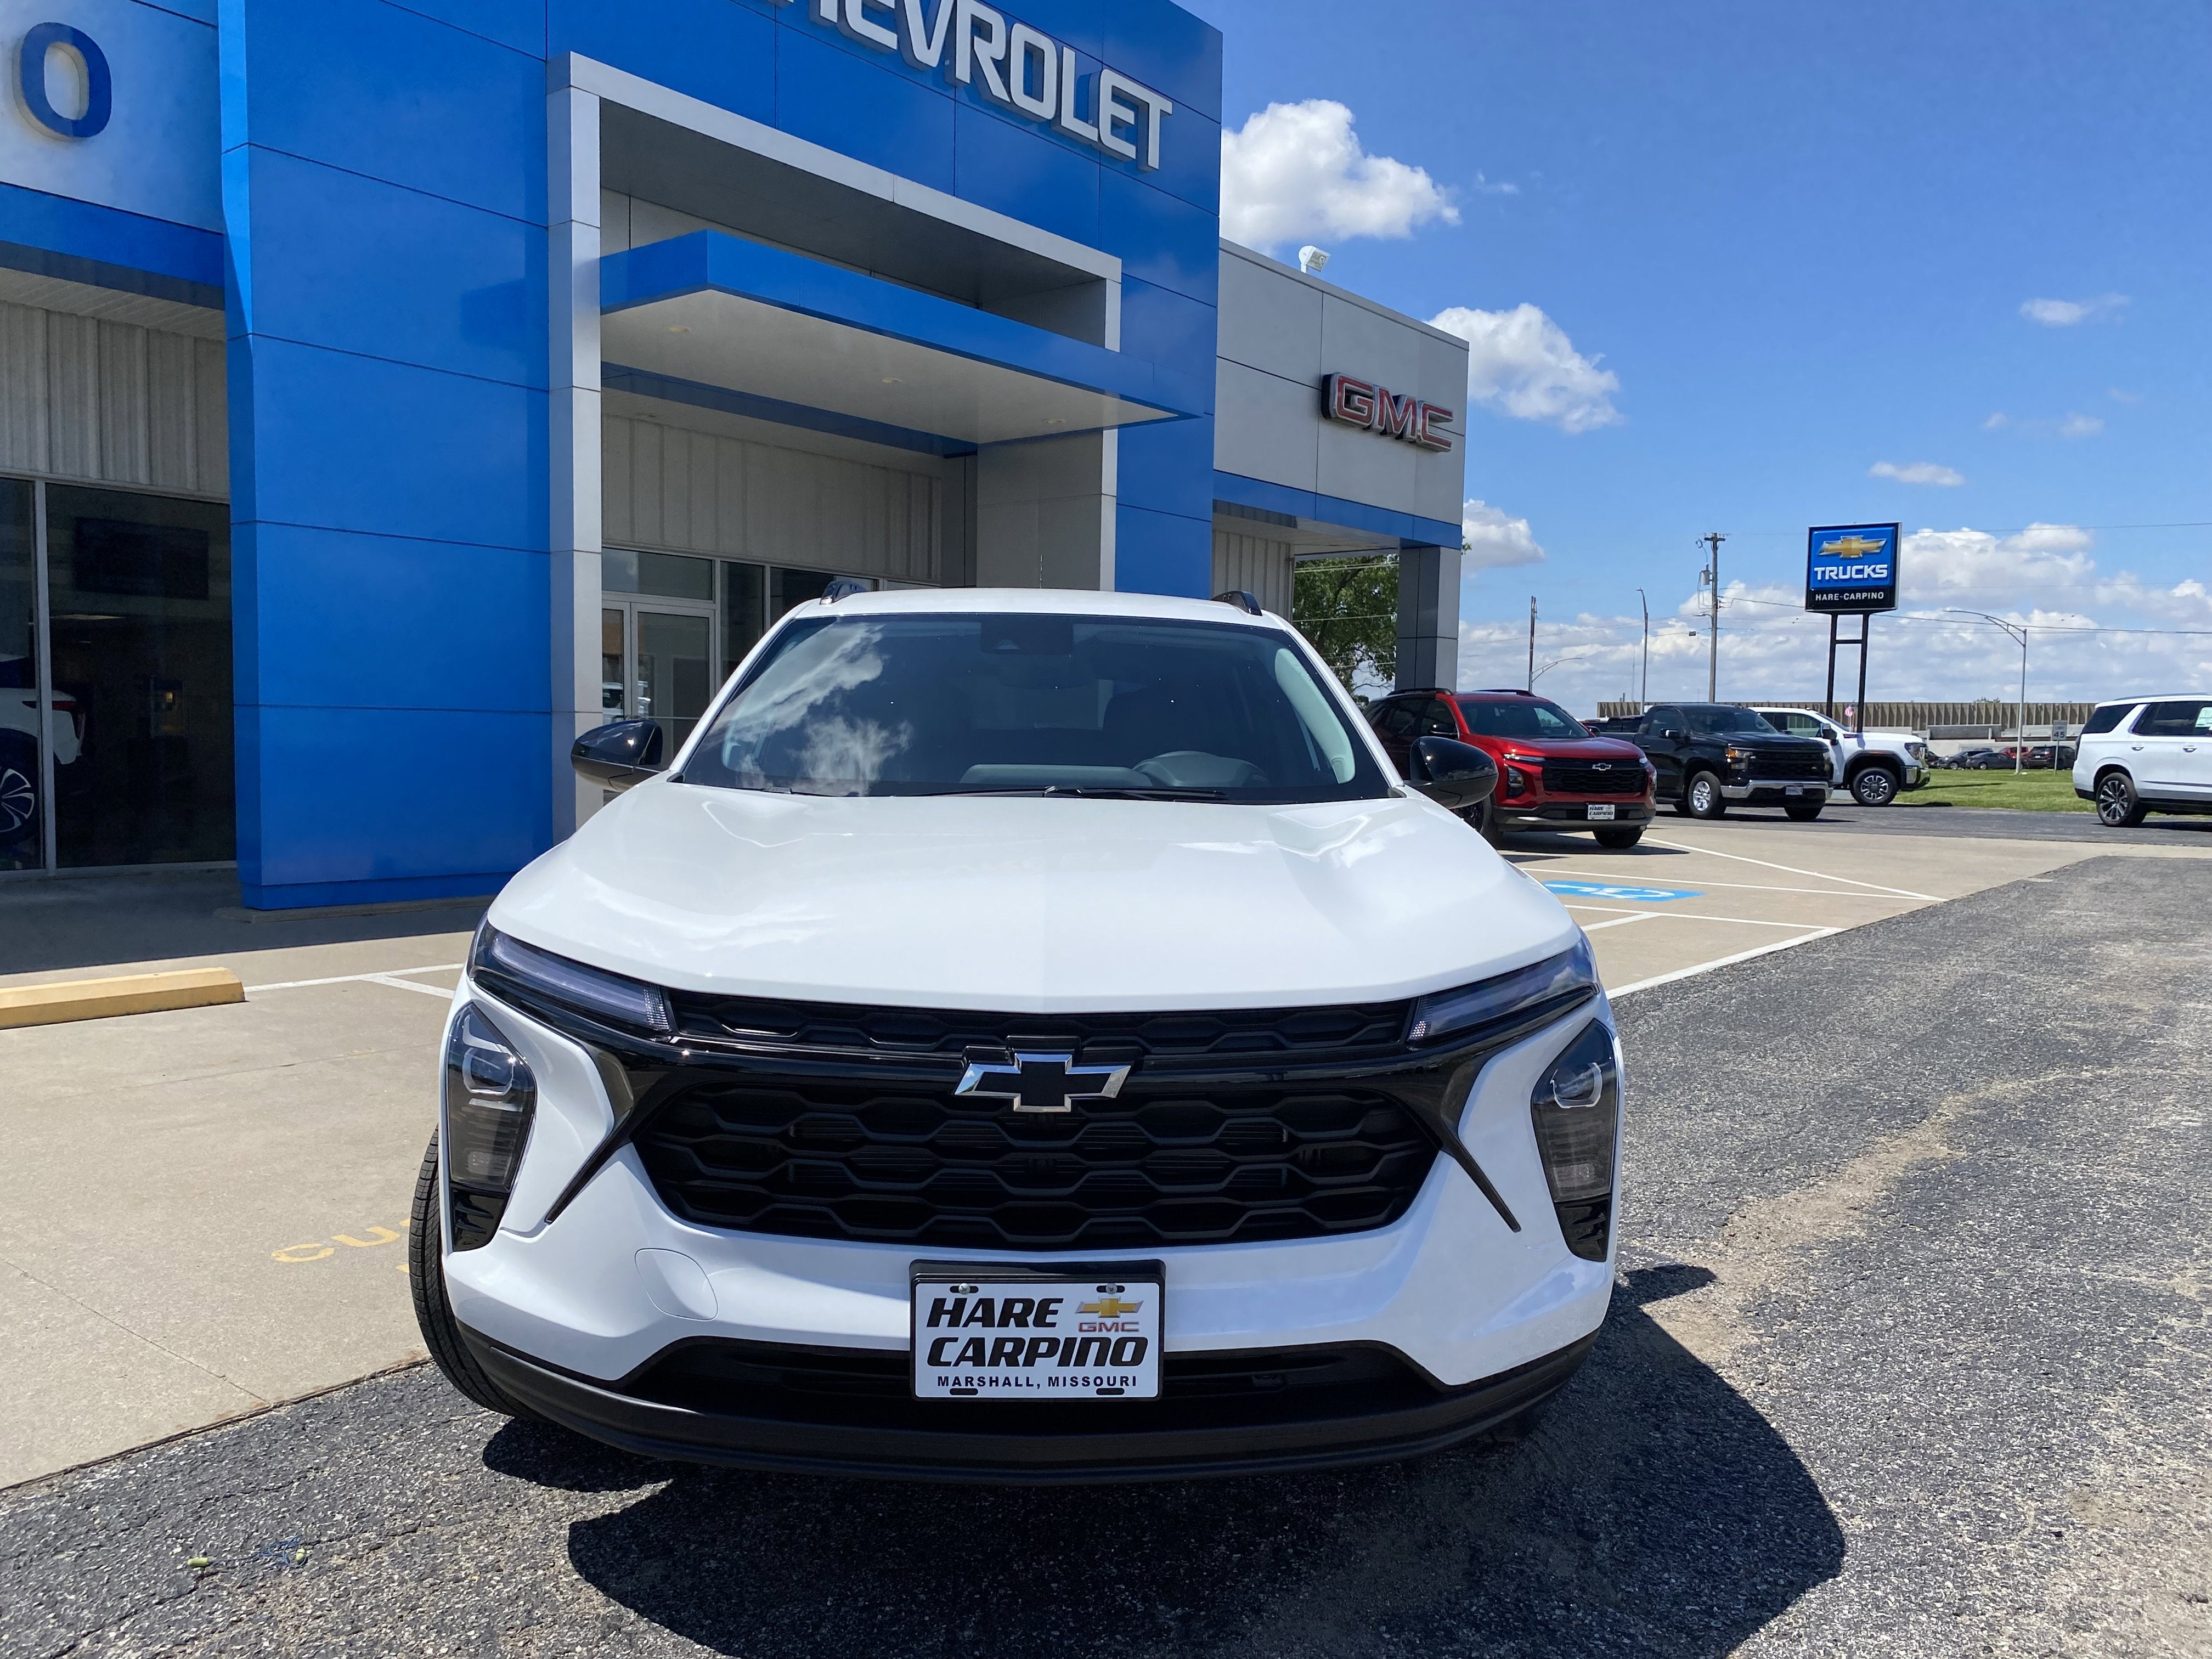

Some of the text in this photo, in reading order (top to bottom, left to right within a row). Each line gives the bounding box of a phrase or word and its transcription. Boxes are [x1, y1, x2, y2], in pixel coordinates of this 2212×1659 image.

[1330, 373, 1453, 451] GMC
[1814, 564, 1888, 580] TRUCKS
[1815, 591, 1884, 601] HARE-CARPINO
[926, 1297, 1064, 1328] HARE
[1078, 1321, 1139, 1333] GMC
[927, 1336, 1148, 1367] CARPINO
[937, 1376, 1137, 1389] MARSHALL, MISSOURI
